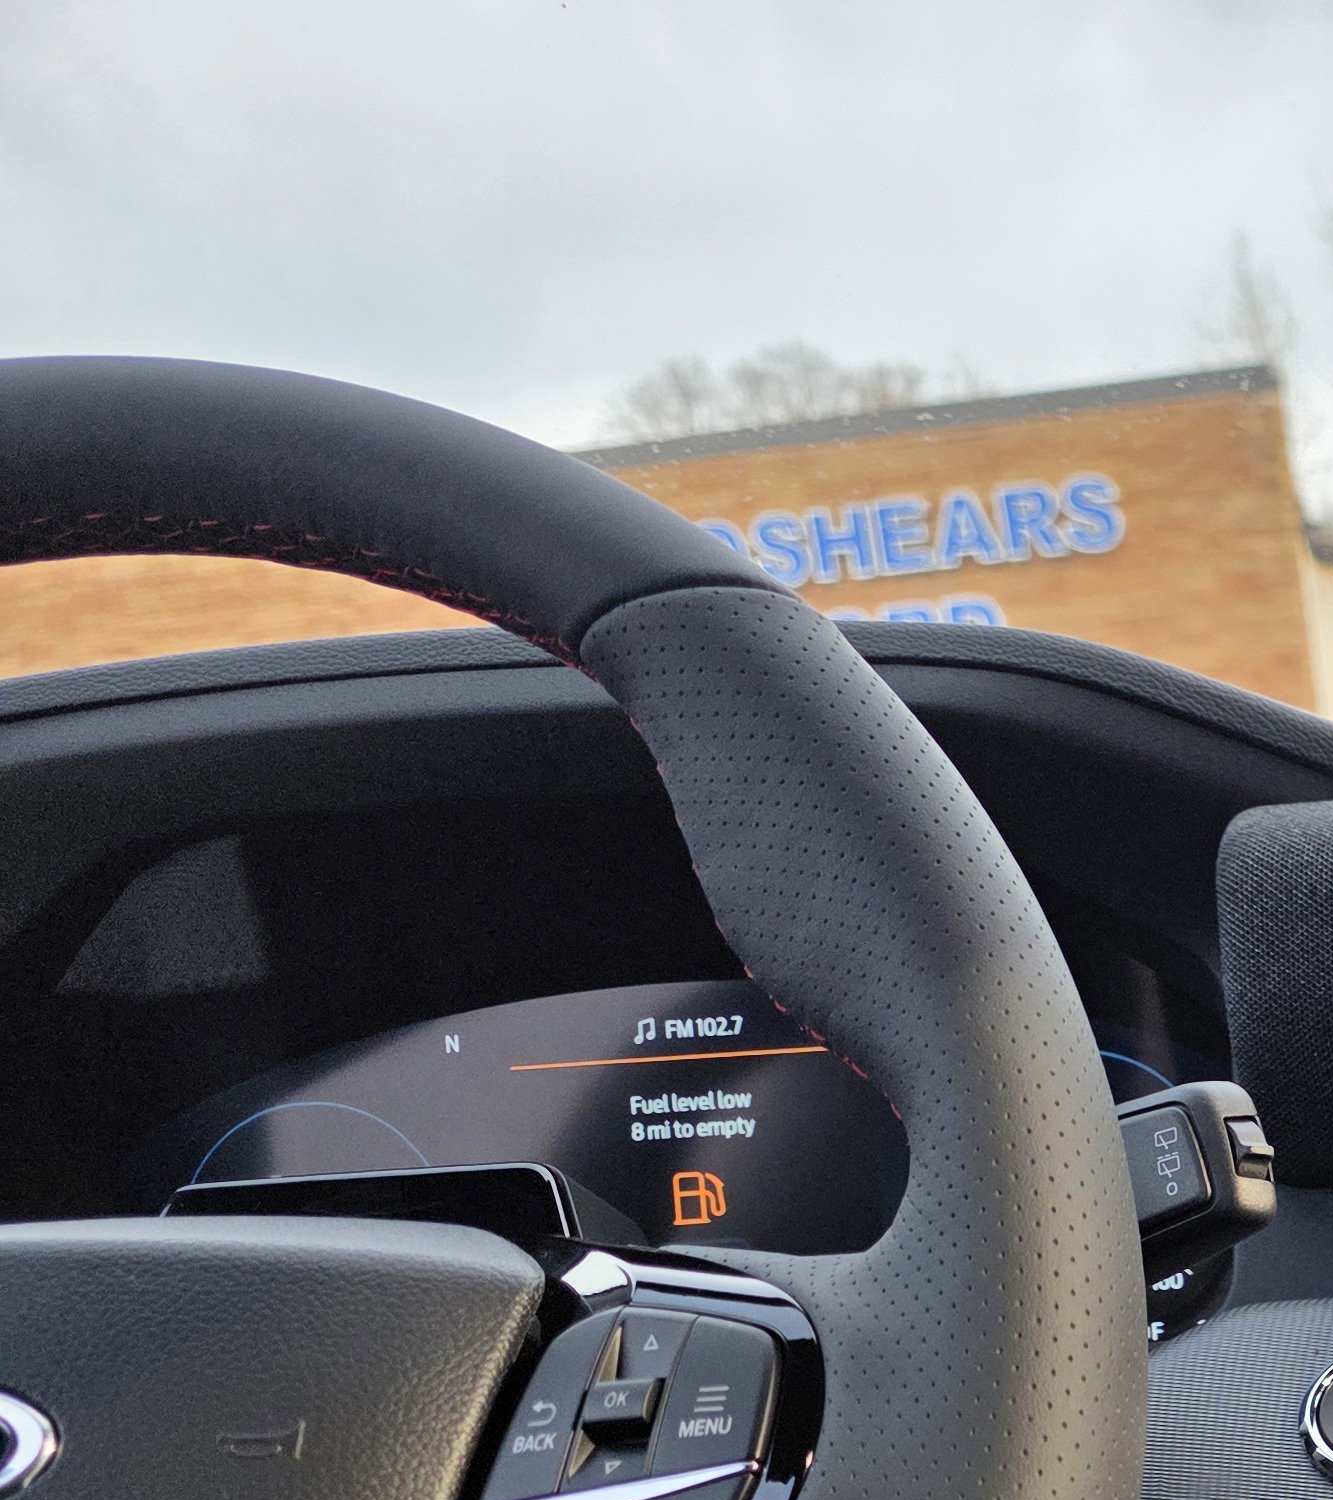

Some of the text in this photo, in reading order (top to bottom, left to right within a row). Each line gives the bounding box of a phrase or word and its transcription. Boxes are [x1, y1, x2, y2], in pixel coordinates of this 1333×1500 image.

[664, 1018, 694, 1039] FM
[444, 1034, 460, 1054] N
[629, 1089, 752, 1116] Fuel level low
[630, 1116, 756, 1142] 8 mi to empty
[603, 1391, 629, 1409] OK
[678, 1416, 733, 1438] MENU
[512, 1433, 556, 1454] BACK
